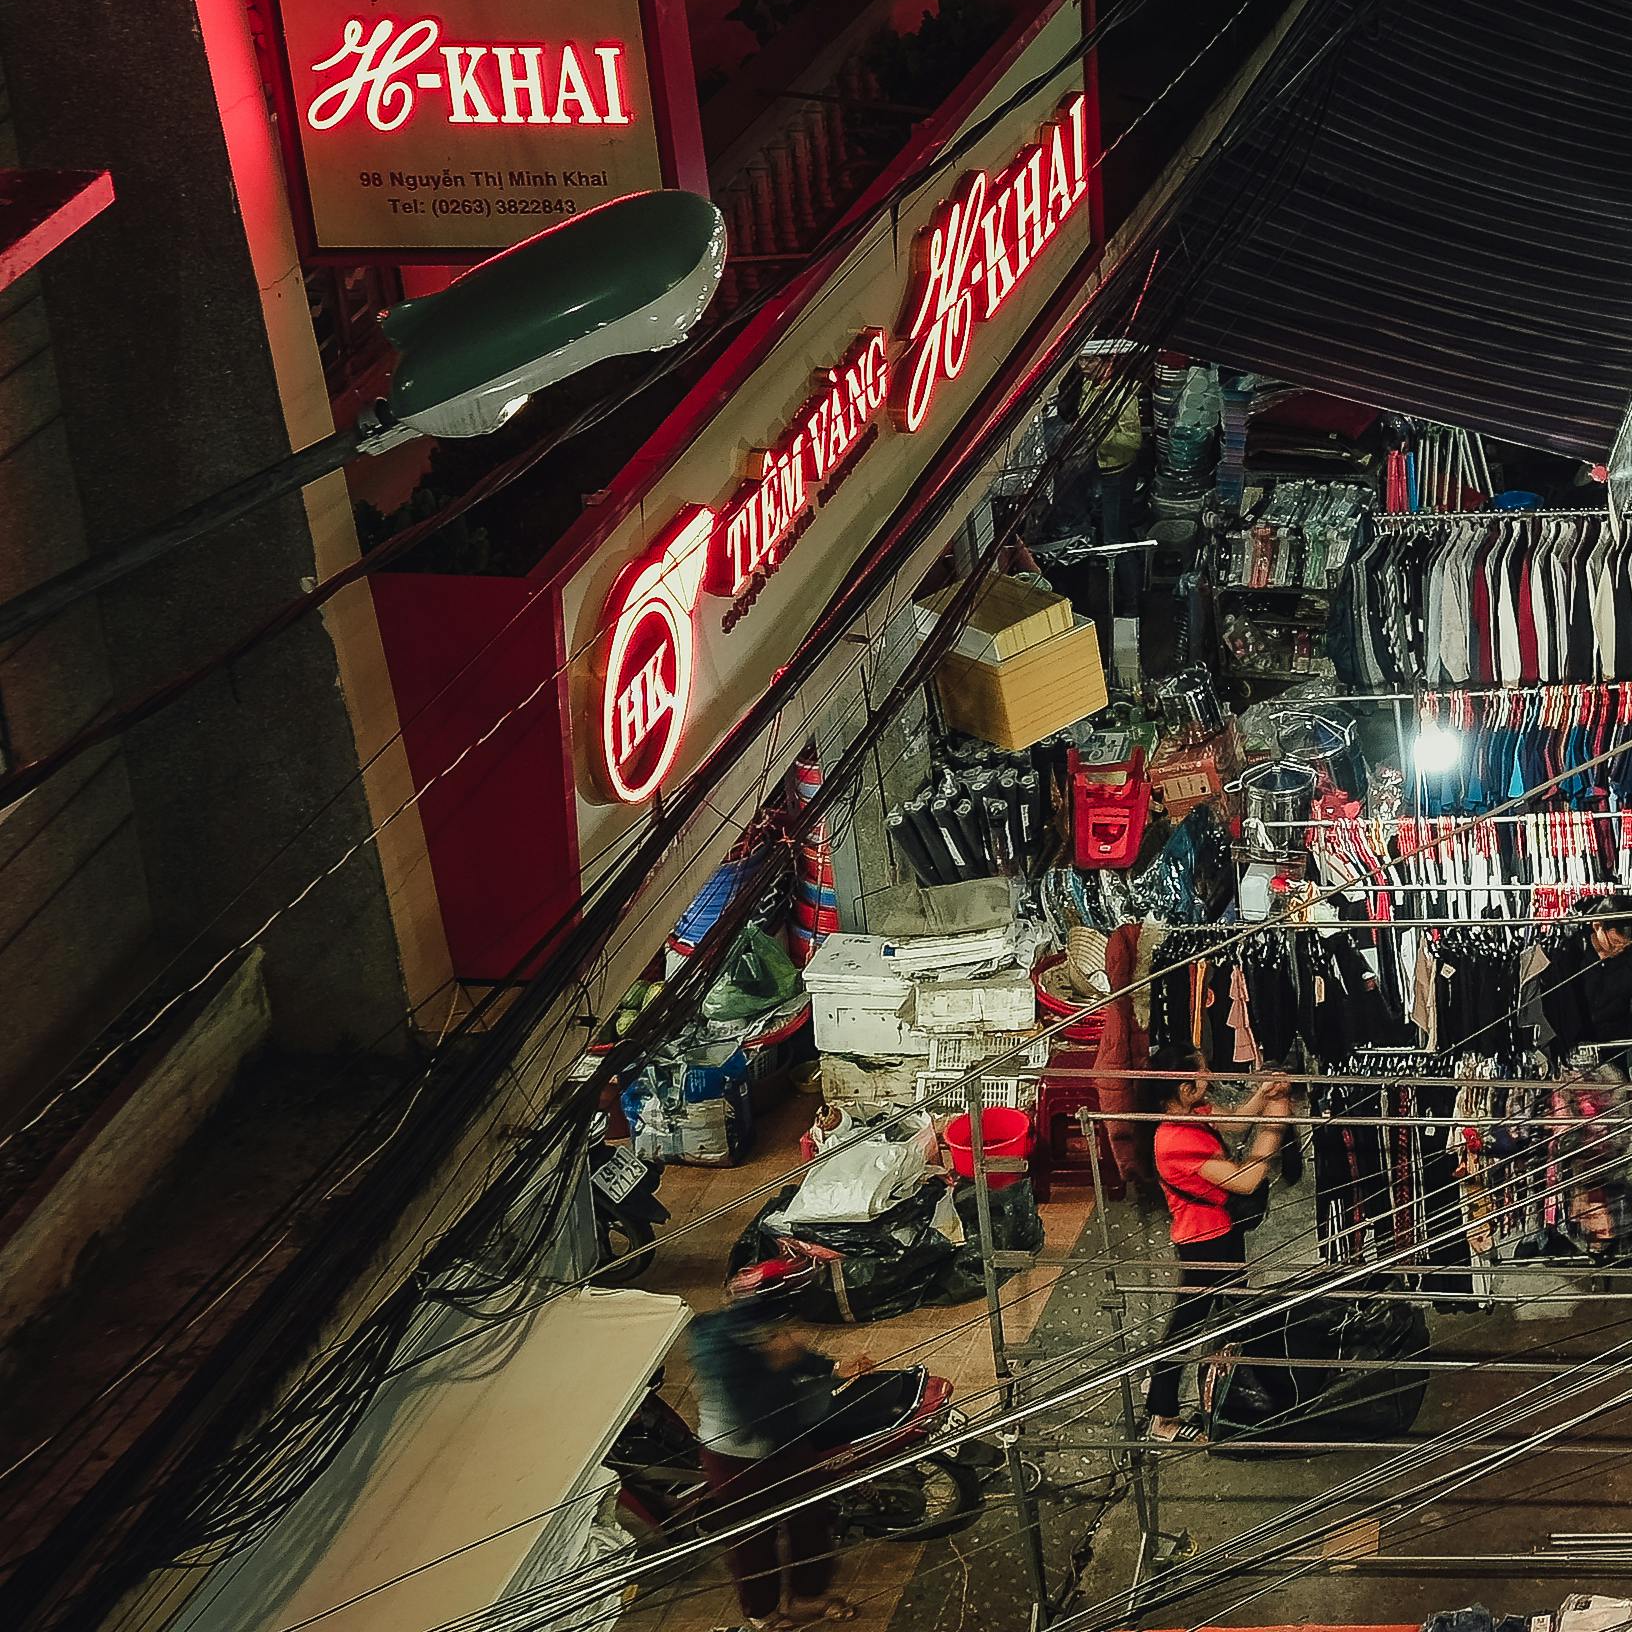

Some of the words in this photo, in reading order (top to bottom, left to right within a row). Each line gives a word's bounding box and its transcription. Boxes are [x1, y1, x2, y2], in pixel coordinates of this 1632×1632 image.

[359, 171, 384, 188] 98
[389, 169, 466, 190] Nguyễn
[470, 170, 504, 190] Thị
[508, 171, 557, 187] Minh
[562, 170, 608, 187] Khai
[388, 198, 426, 214] Tel:
[431, 198, 491, 218] (0263)
[496, 198, 577, 215] 3822843
[726, 438, 805, 579] TIỆM
[809, 331, 889, 486] VÀNG
[615, 638, 675, 765] HK
